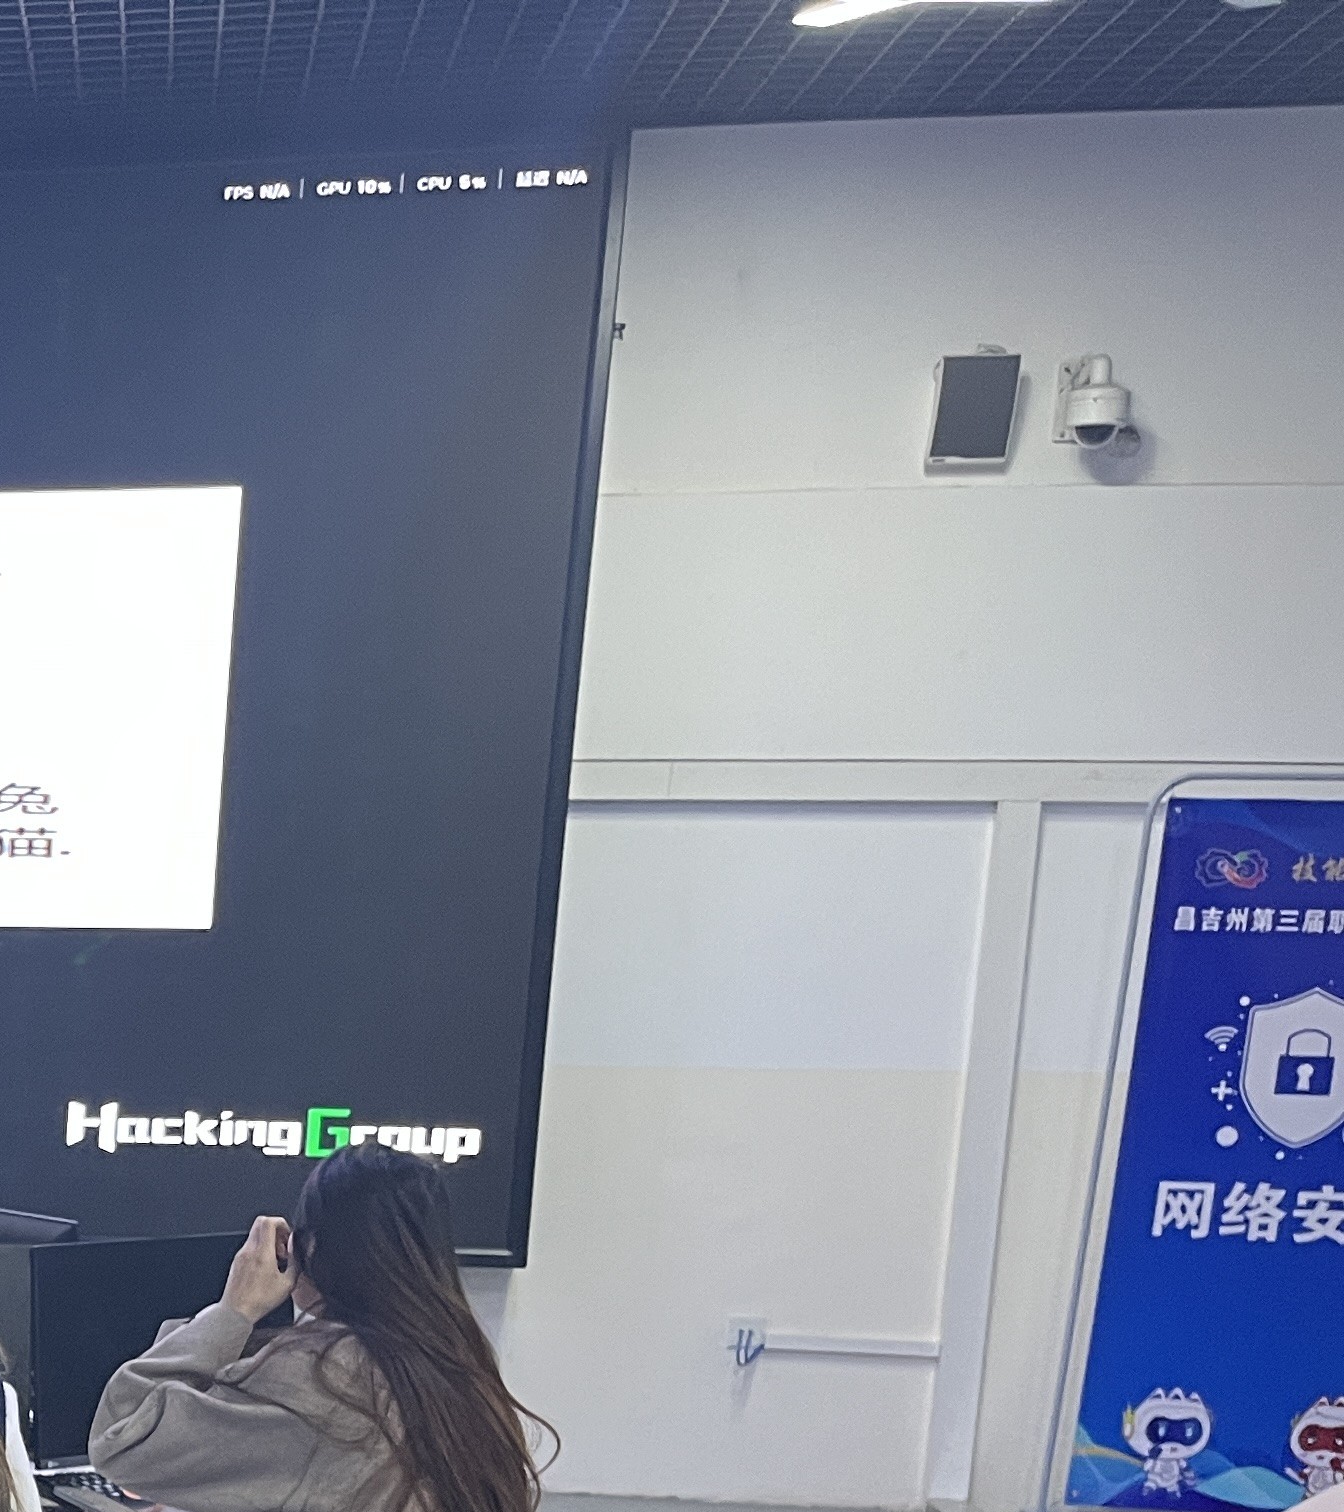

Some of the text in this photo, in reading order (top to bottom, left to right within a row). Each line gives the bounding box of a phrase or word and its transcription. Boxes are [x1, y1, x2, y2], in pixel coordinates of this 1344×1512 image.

[416, 175, 453, 192] CPU
[555, 169, 589, 186] N/A
[260, 182, 292, 200] N/A
[316, 178, 393, 196] GPU 10%
[65, 1099, 483, 1164] HackingGroup
[1152, 1181, 1344, 1245] 网络安
